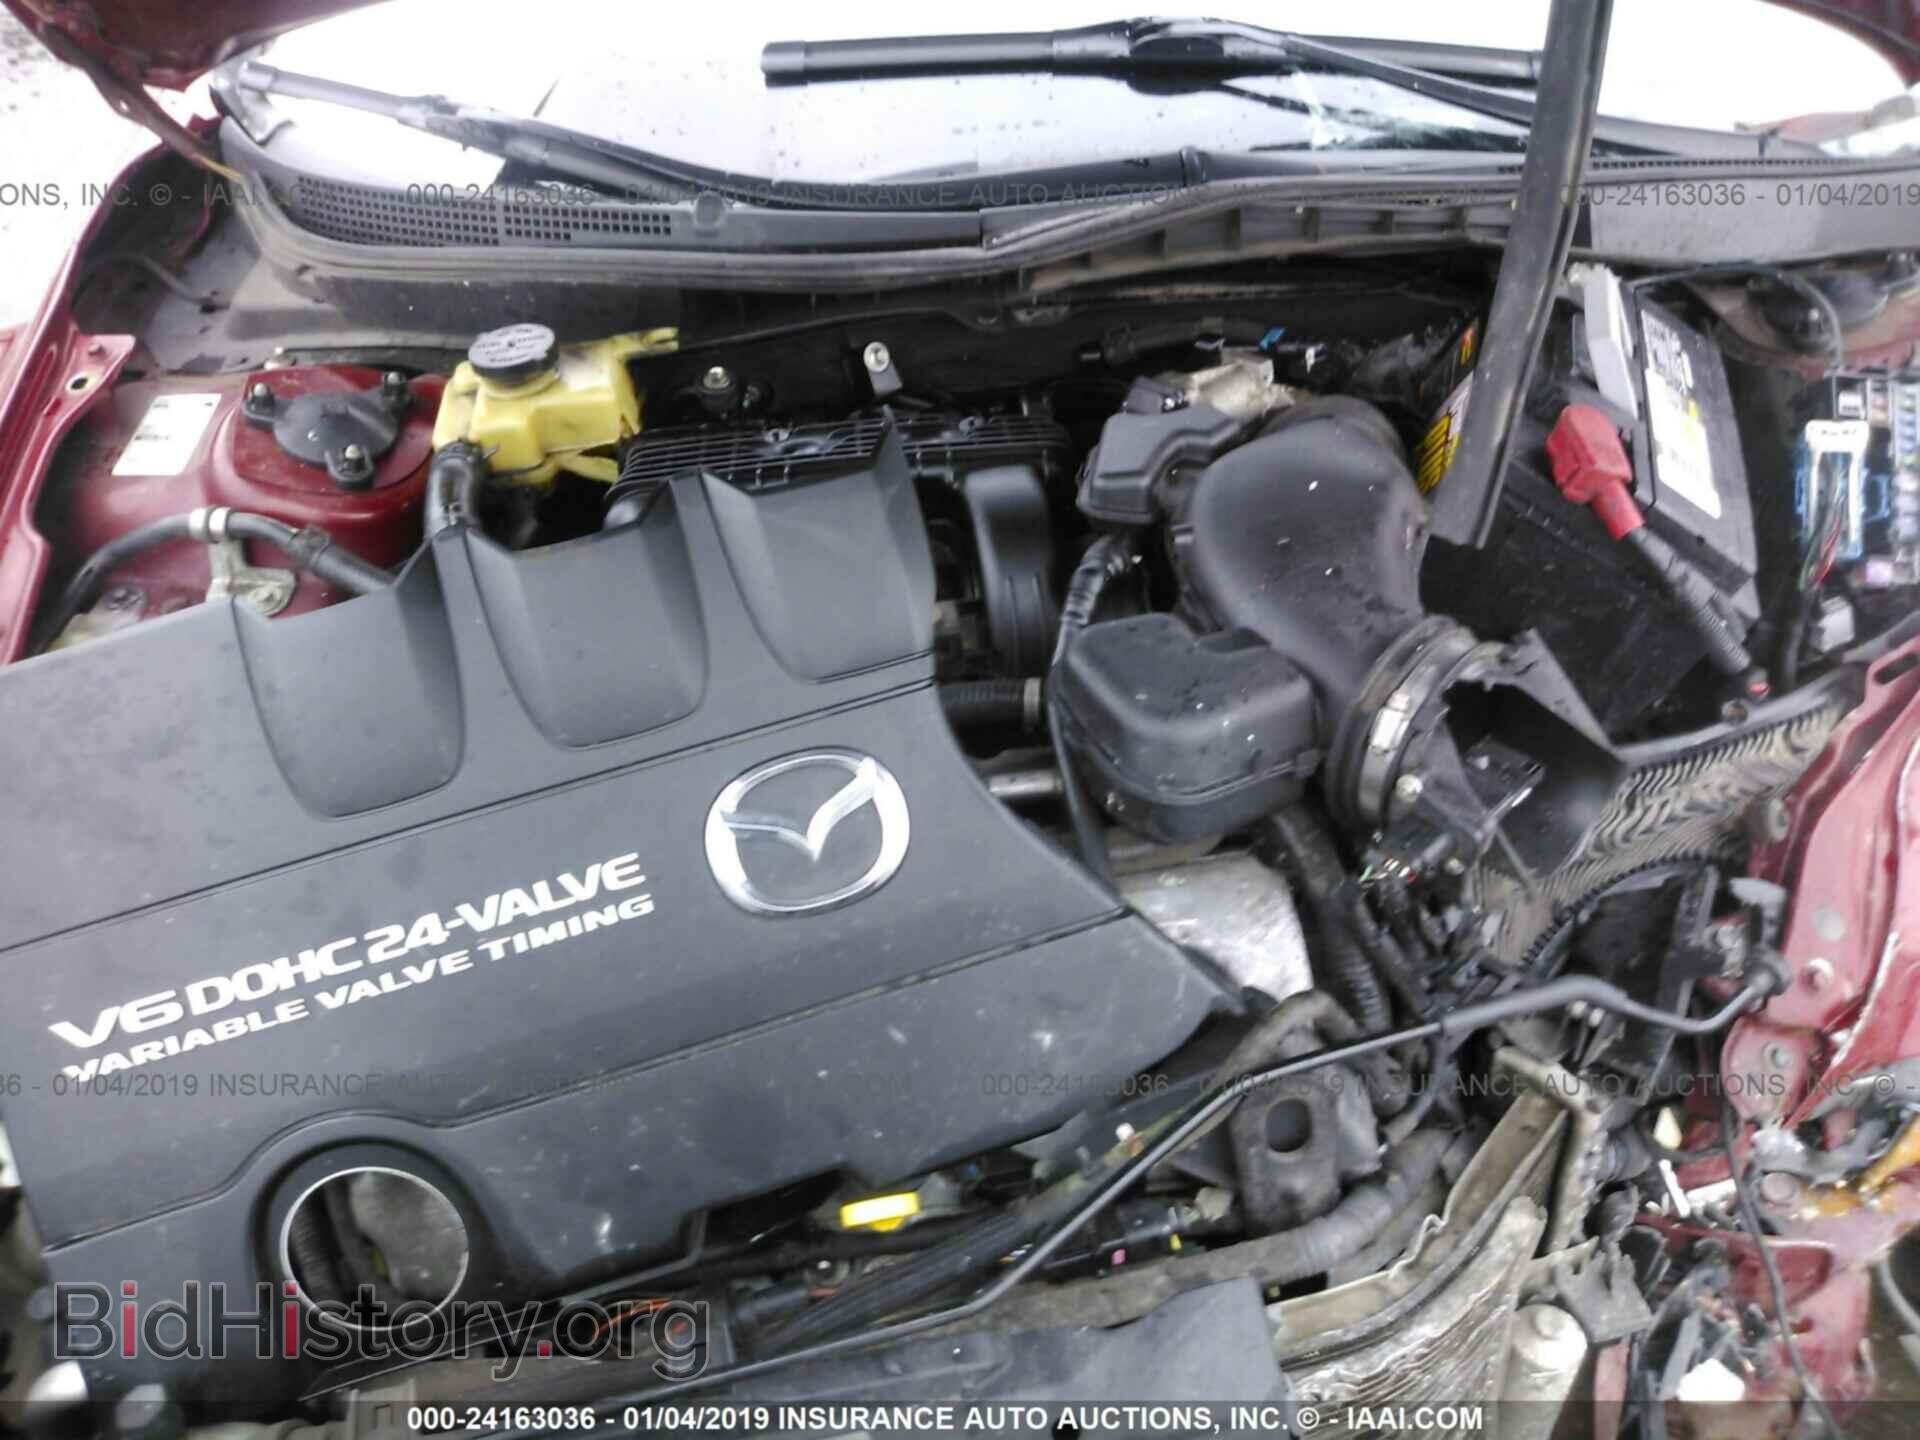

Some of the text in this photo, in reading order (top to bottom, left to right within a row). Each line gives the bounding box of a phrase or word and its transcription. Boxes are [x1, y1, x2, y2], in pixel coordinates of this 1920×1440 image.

[48, 852, 645, 1049] V6 DOHC 24-VALVE
[62, 893, 655, 1083] VARIABLE VALVE TIMING
